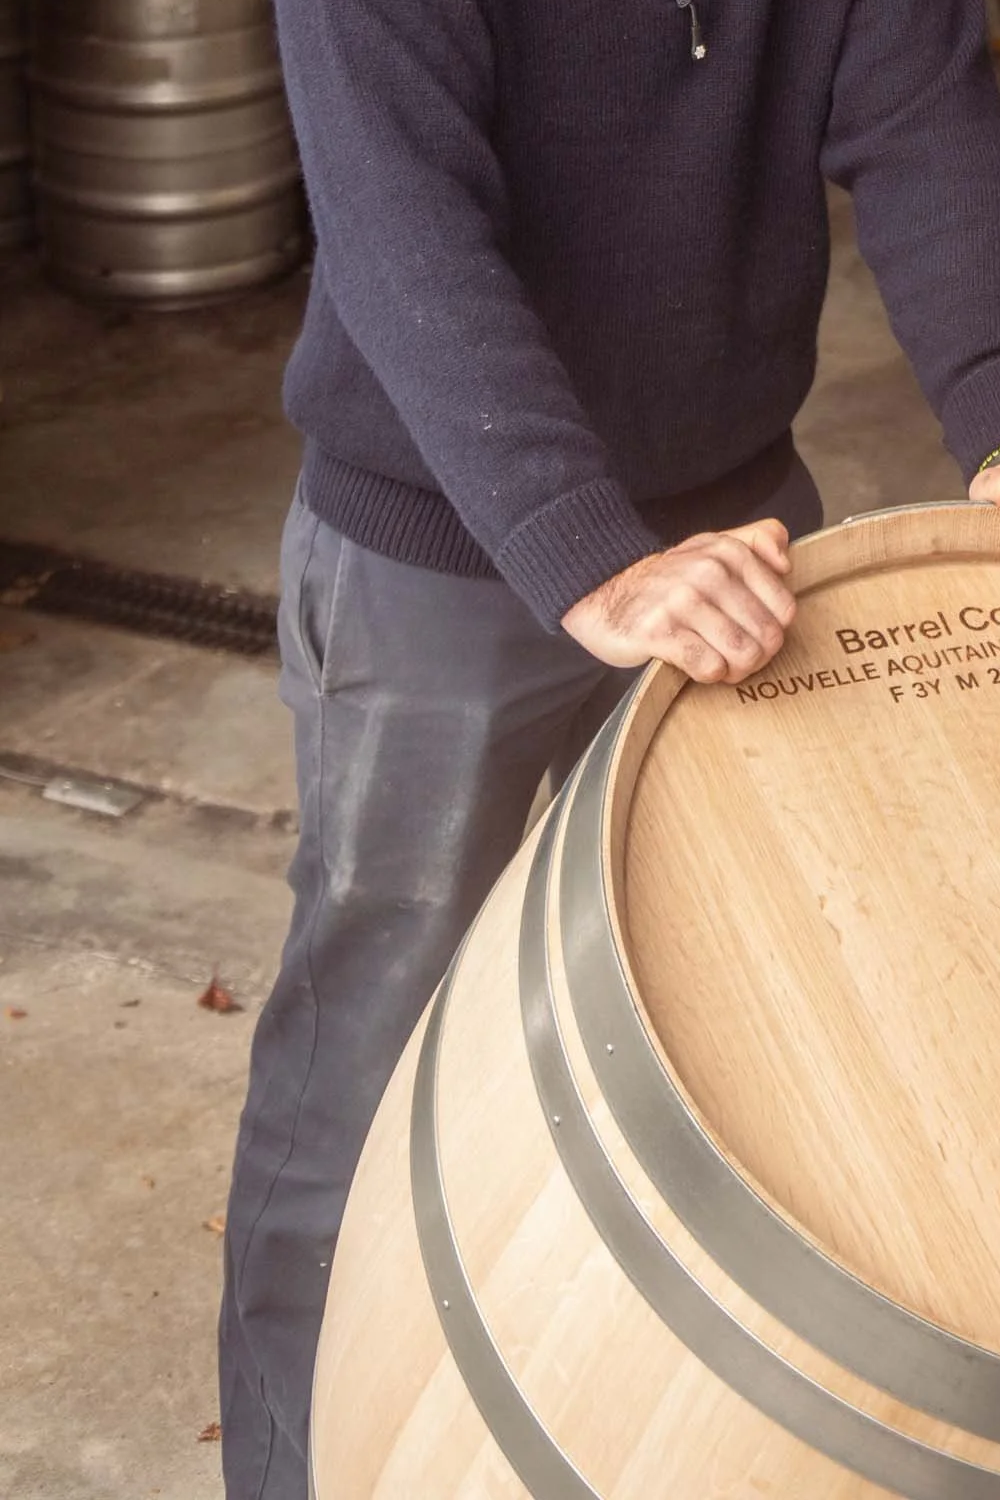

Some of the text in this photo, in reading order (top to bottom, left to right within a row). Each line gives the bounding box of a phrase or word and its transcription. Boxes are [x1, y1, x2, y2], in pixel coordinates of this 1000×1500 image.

[835, 611, 953, 655] Barrel
[735, 662, 881, 704] NOUVELLE
[889, 685, 904, 703] F
[911, 679, 941, 699] 3Y
[955, 672, 980, 691] M
